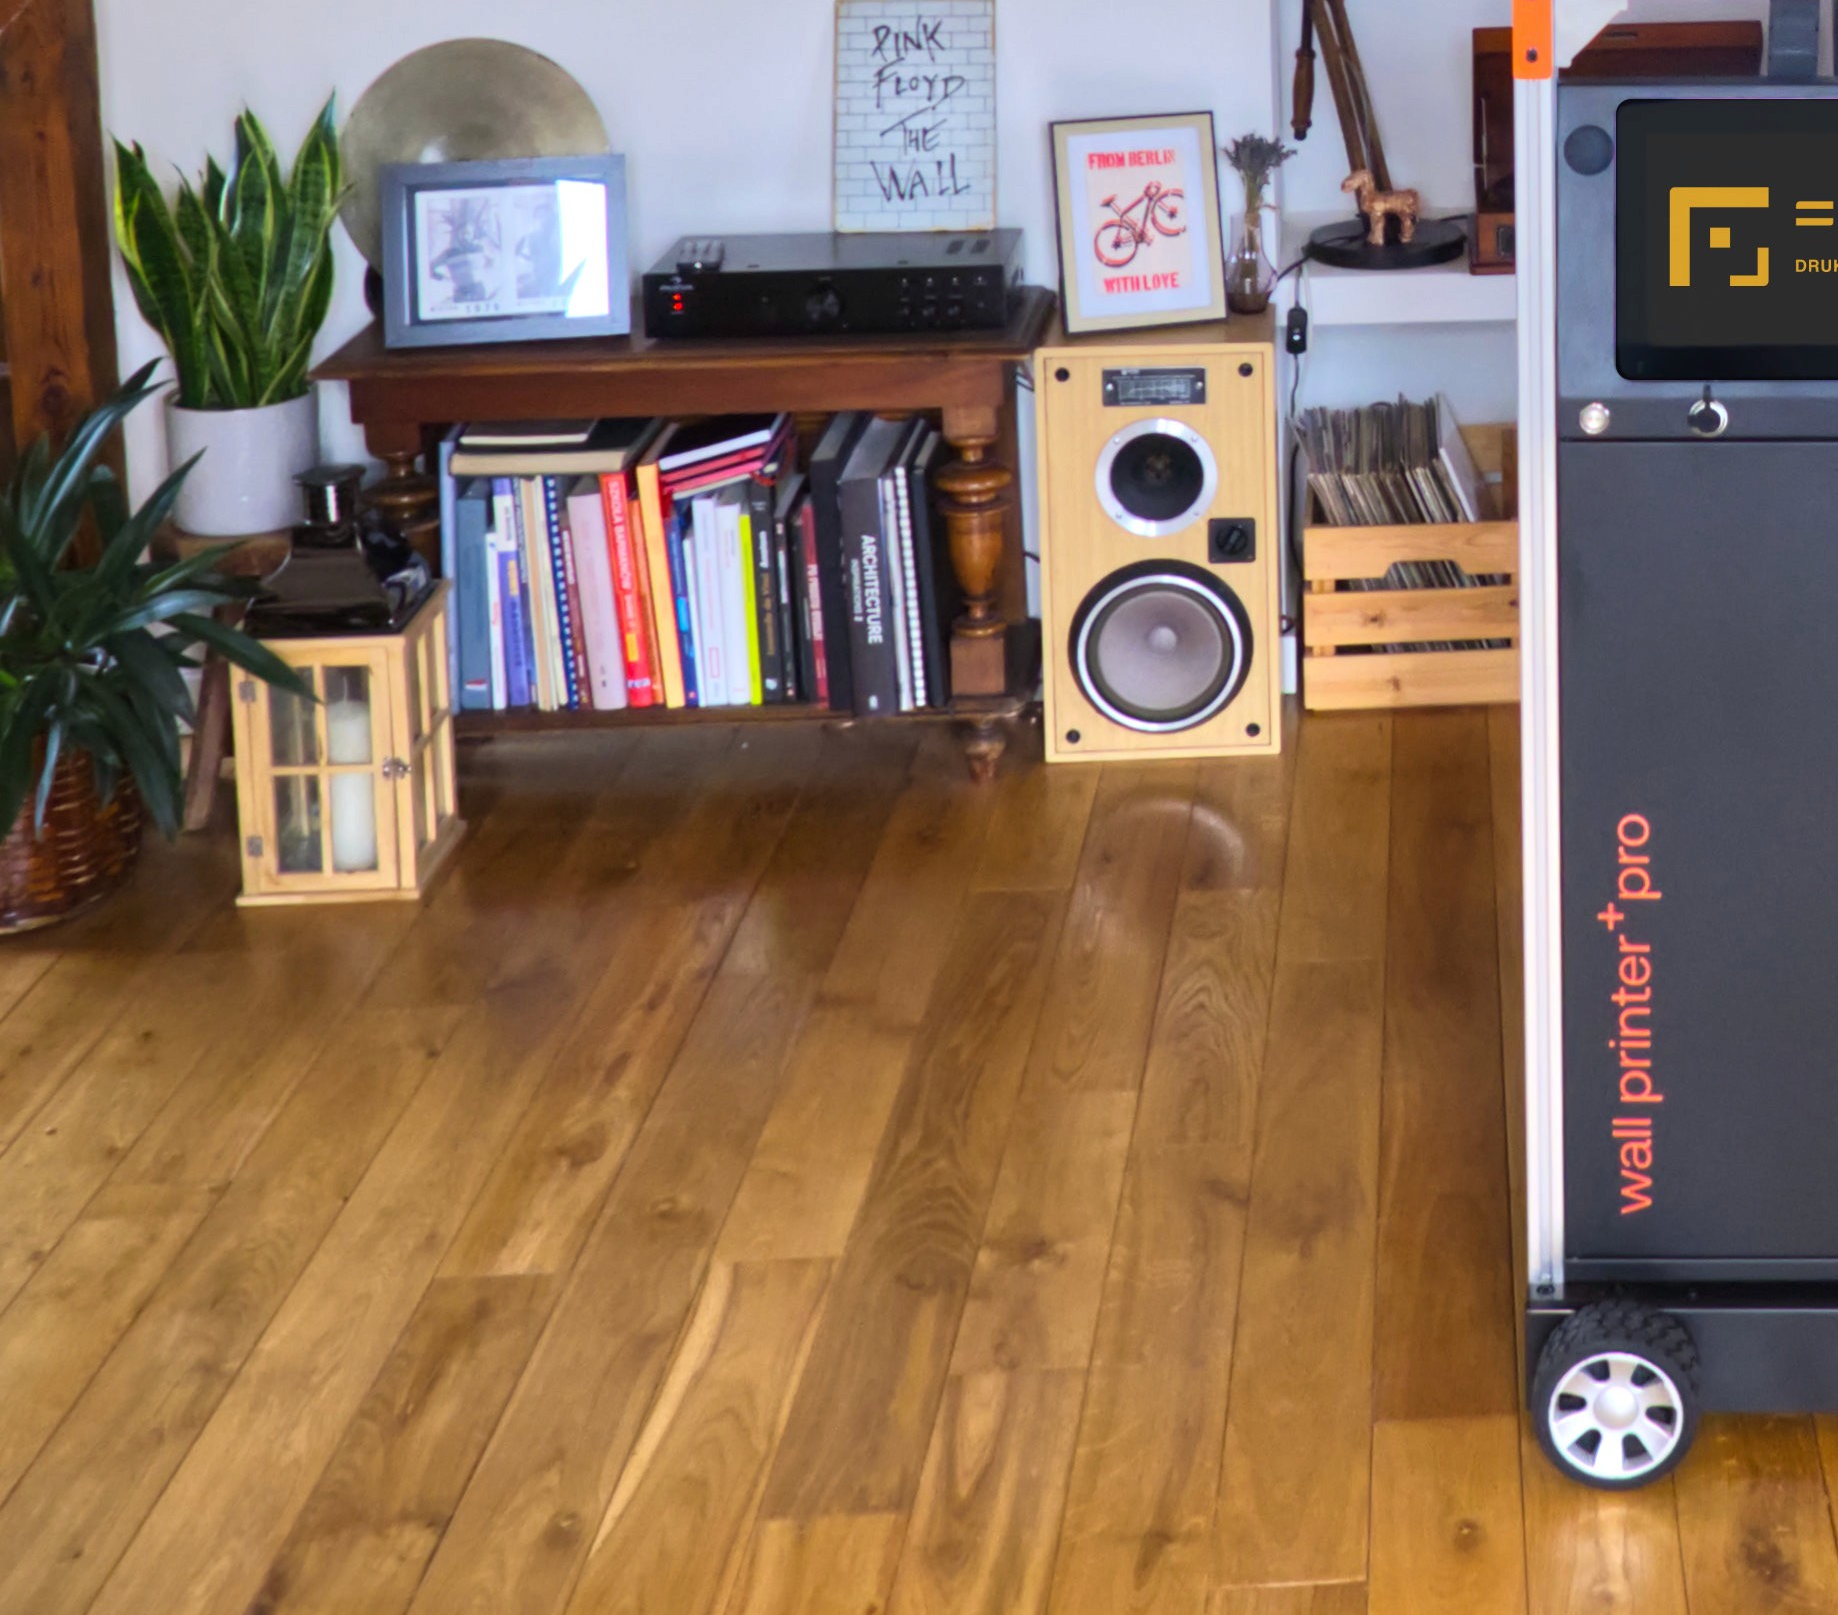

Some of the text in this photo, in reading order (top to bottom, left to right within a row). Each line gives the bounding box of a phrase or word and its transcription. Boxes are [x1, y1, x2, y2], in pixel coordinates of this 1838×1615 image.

[872, 15, 945, 62] PINK
[870, 153, 970, 202] WALL
[1088, 148, 1176, 170] FROM BERLIN
[1103, 272, 1180, 294] WITH LOVE
[861, 535, 883, 644] ARCHITECTURE
[1612, 1118, 1652, 1214] wall
